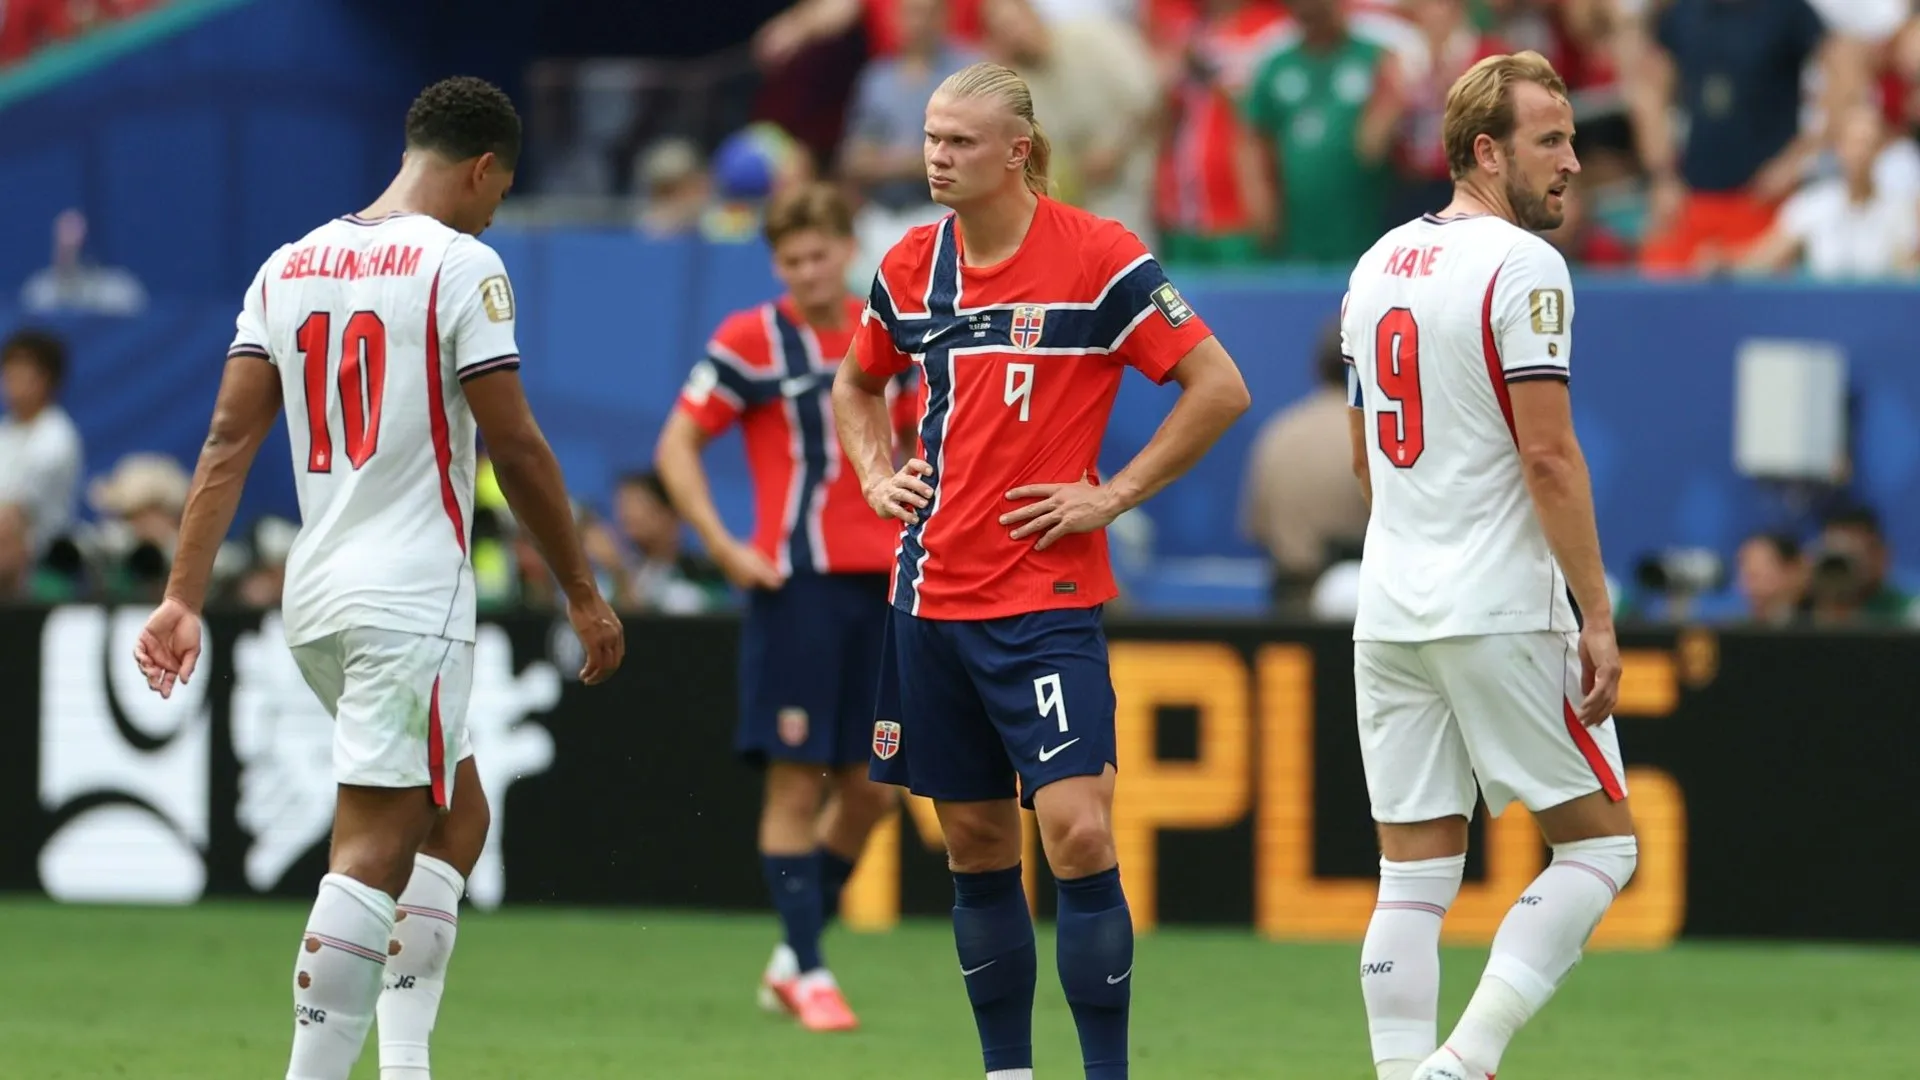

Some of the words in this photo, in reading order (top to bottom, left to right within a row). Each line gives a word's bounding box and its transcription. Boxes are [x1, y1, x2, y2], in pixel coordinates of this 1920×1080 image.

[296, 311, 386, 473] 10
[1003, 362, 1035, 422] 9
[1375, 307, 1424, 468] 9
[1033, 672, 1069, 732] 9
